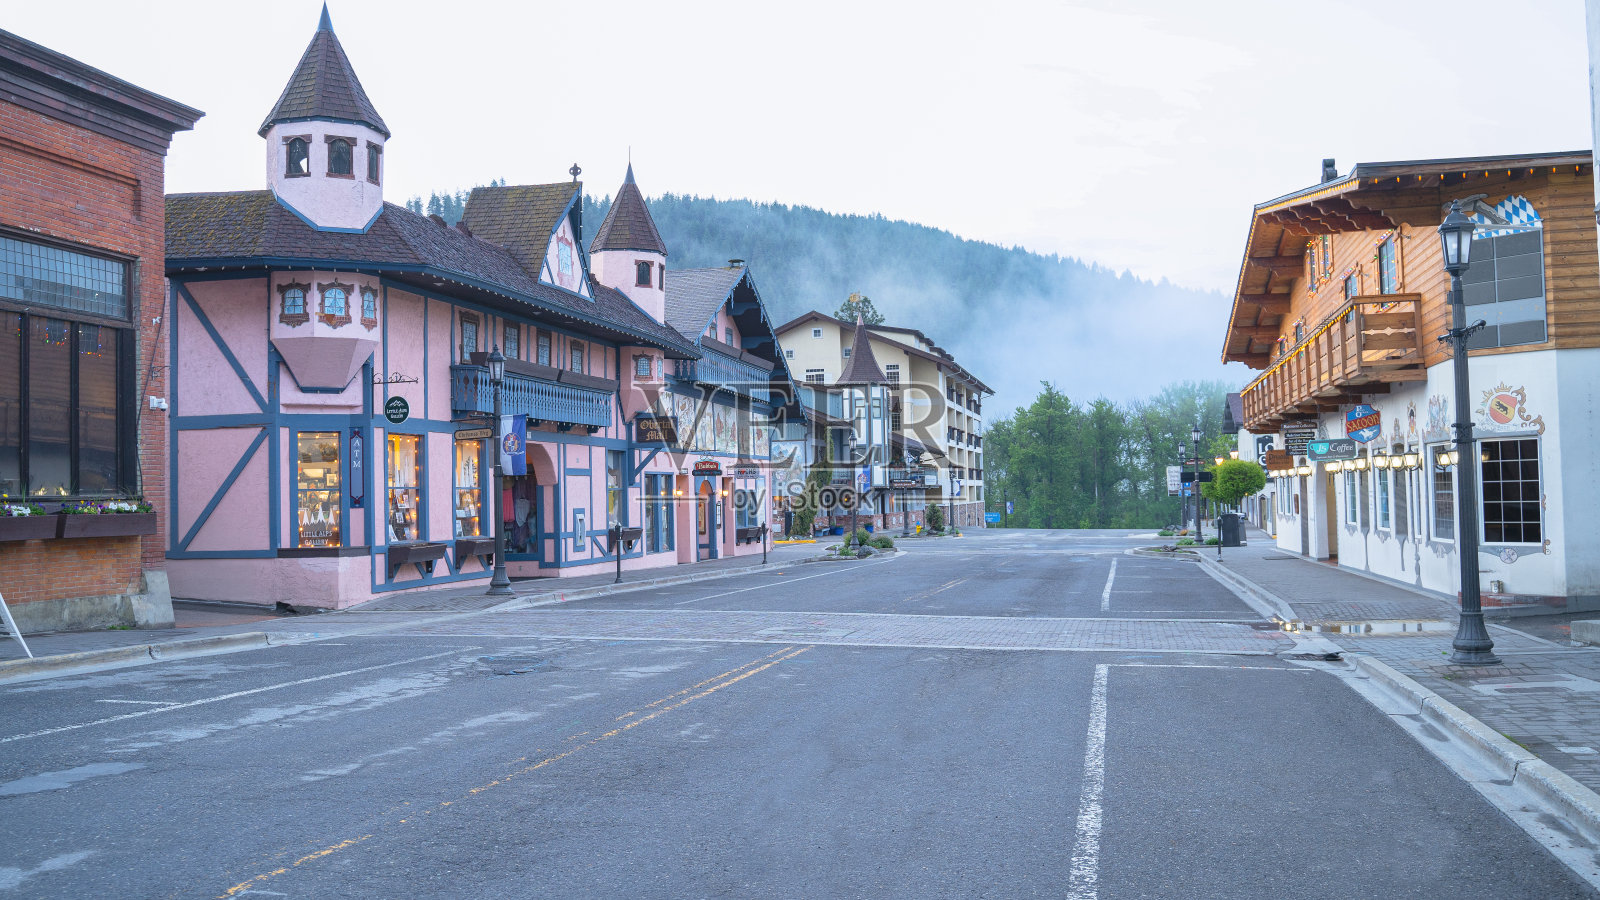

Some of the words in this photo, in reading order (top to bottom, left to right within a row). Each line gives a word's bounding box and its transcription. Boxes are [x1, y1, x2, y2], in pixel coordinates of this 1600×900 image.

[1346, 414, 1380, 433] SALOON
[645, 430, 668, 441] Mall
[352, 439, 361, 468] ATM
[1330, 442, 1354, 453] Coffee
